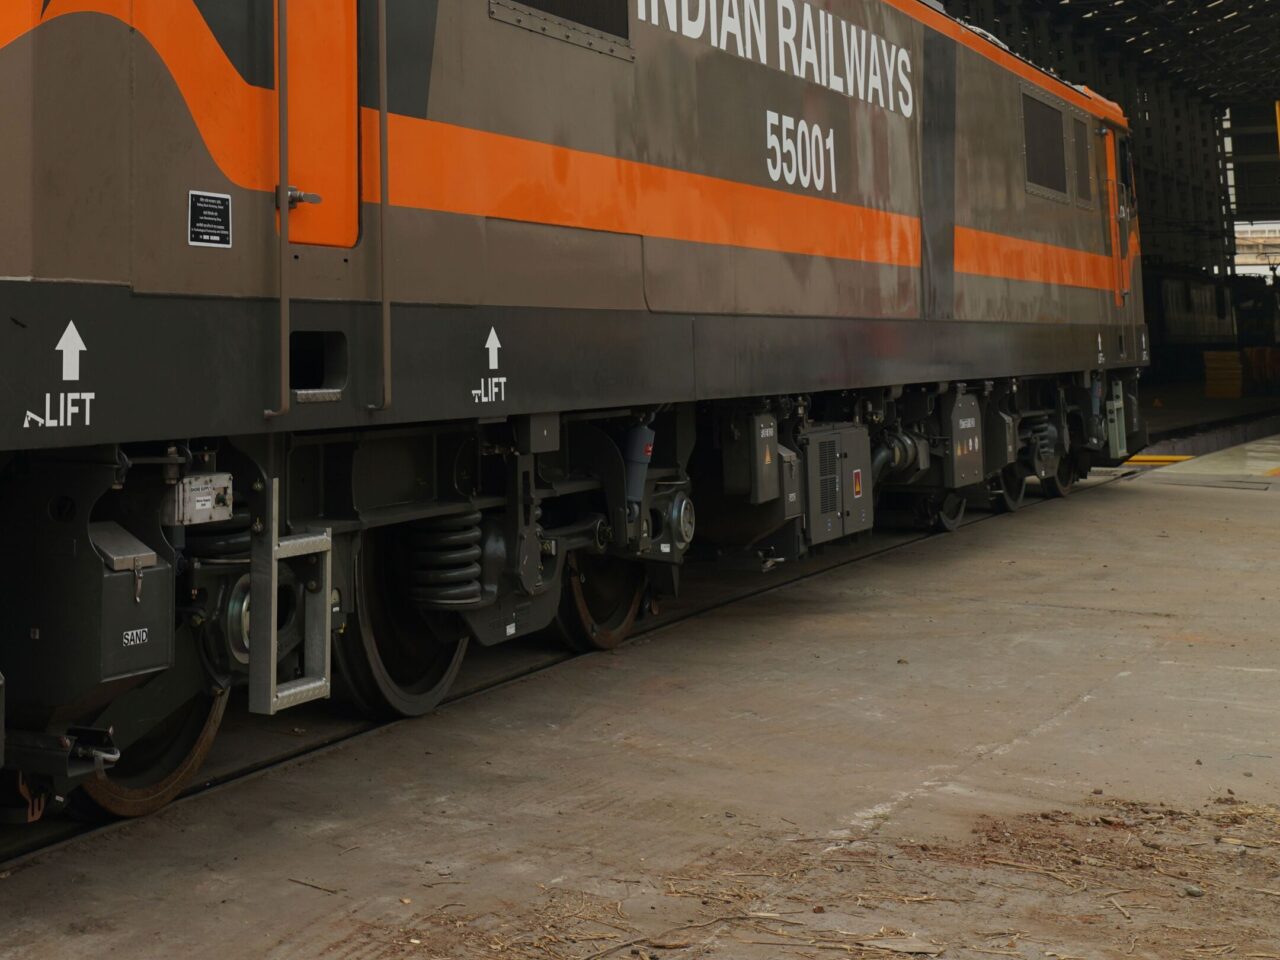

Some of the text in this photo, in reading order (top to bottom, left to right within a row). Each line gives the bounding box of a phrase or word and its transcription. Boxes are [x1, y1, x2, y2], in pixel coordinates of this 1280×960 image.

[766, 109, 837, 194] 55001
[481, 376, 507, 403] LIFT
[45, 392, 96, 427] LIFT
[123, 629, 148, 646] SAND
